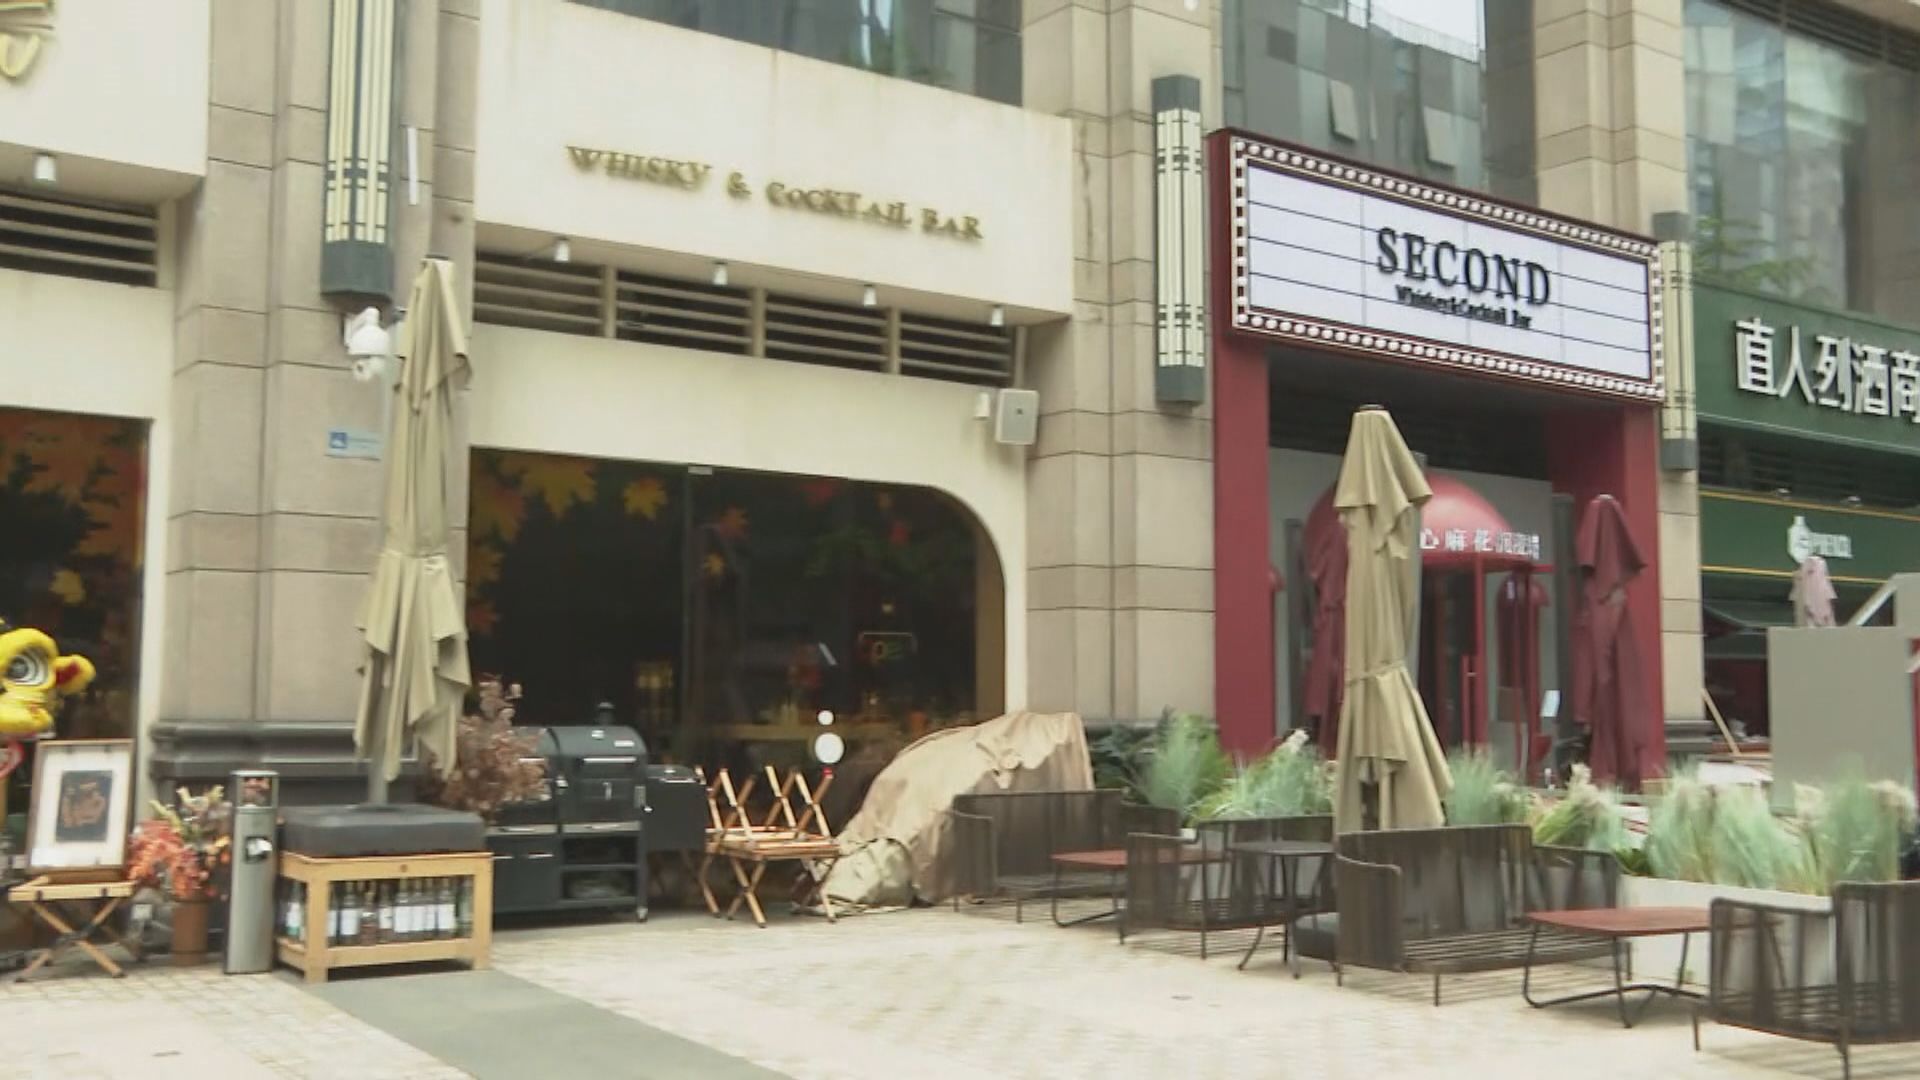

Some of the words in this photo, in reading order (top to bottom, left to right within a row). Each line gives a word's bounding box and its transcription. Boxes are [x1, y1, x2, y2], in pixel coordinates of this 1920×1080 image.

[566, 145, 712, 192] WHISKY
[727, 171, 752, 199] &
[1377, 227, 1551, 305] SECOND
